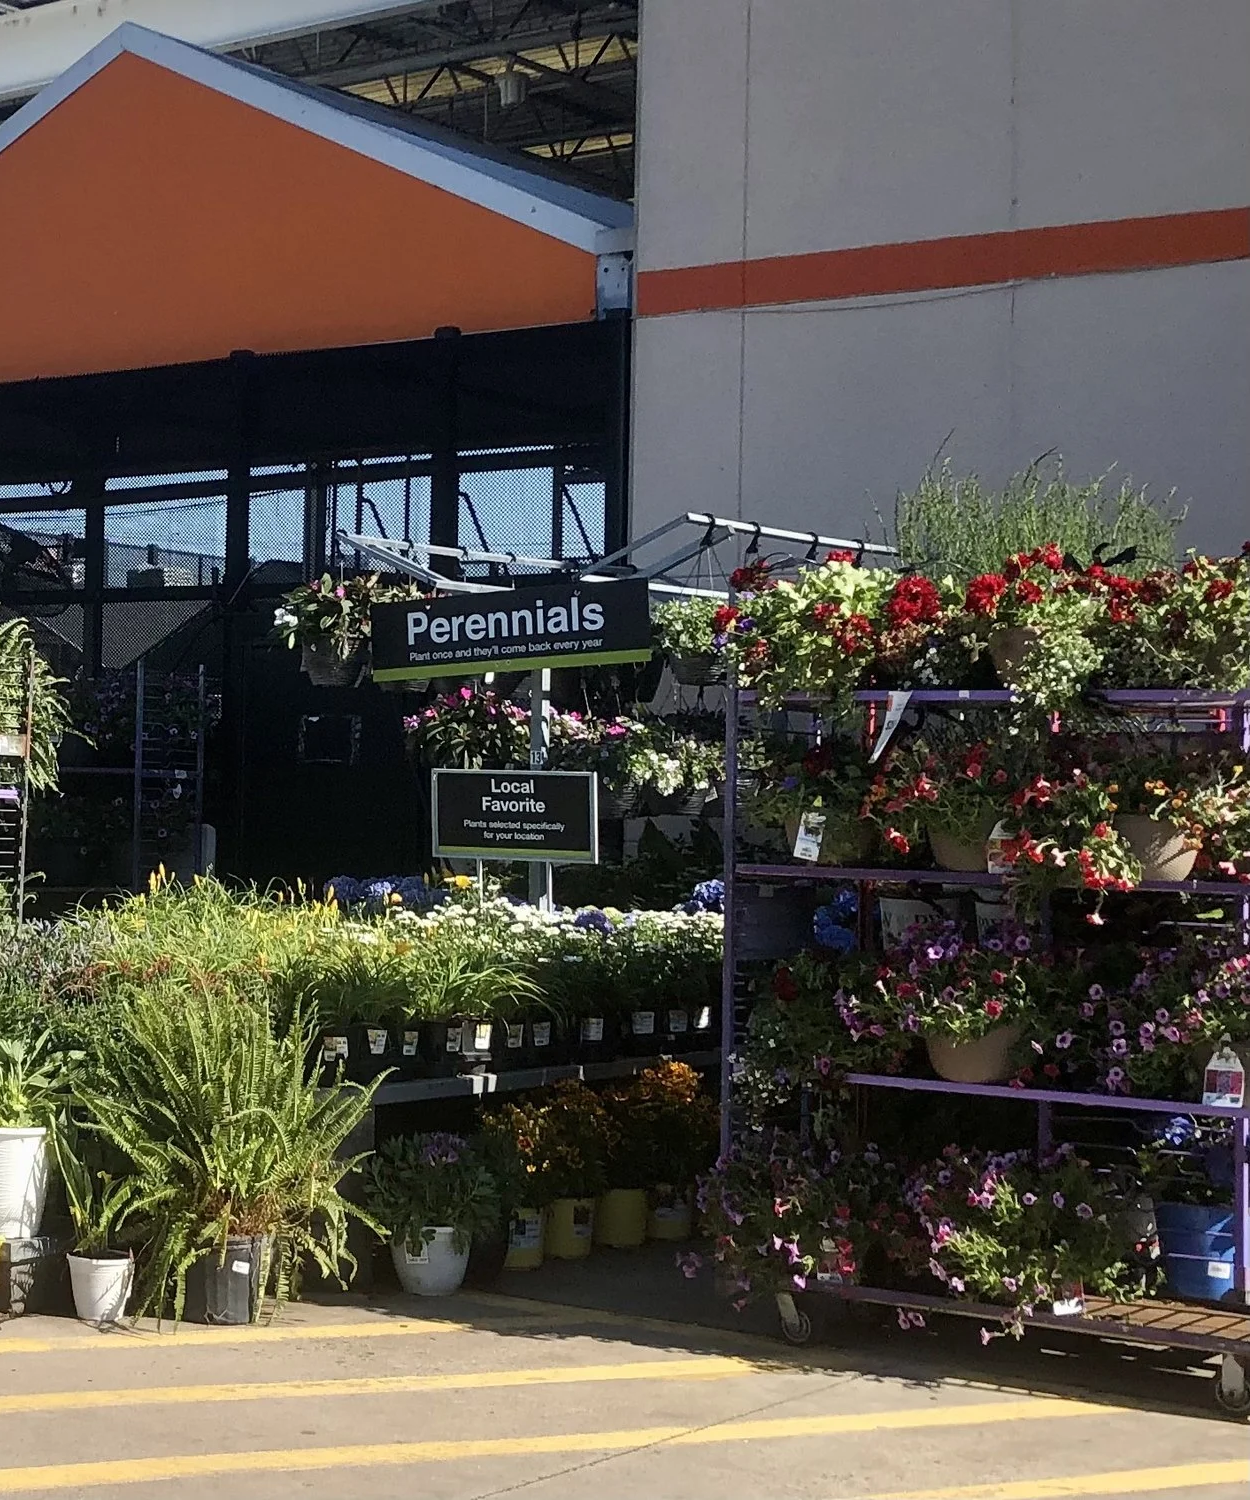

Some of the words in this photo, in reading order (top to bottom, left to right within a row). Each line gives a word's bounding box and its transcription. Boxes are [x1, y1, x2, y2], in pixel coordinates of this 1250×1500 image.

[407, 596, 605, 646] Perennials
[409, 651, 431, 662] Plant
[432, 650, 453, 660] once
[455, 648, 472, 658] and
[473, 645, 499, 658] they'll
[501, 645, 527, 654] come
[529, 642, 552, 652] back
[553, 641, 579, 652] every
[581, 638, 604, 650] year
[490, 778, 535, 794] Local
[481, 796, 546, 813] Favorite
[463, 819, 487, 828] Plants
[488, 820, 521, 829] selected
[522, 821, 565, 832] specifically
[483, 831, 494, 839] for
[495, 832, 513, 842] your
[514, 831, 545, 841] location
